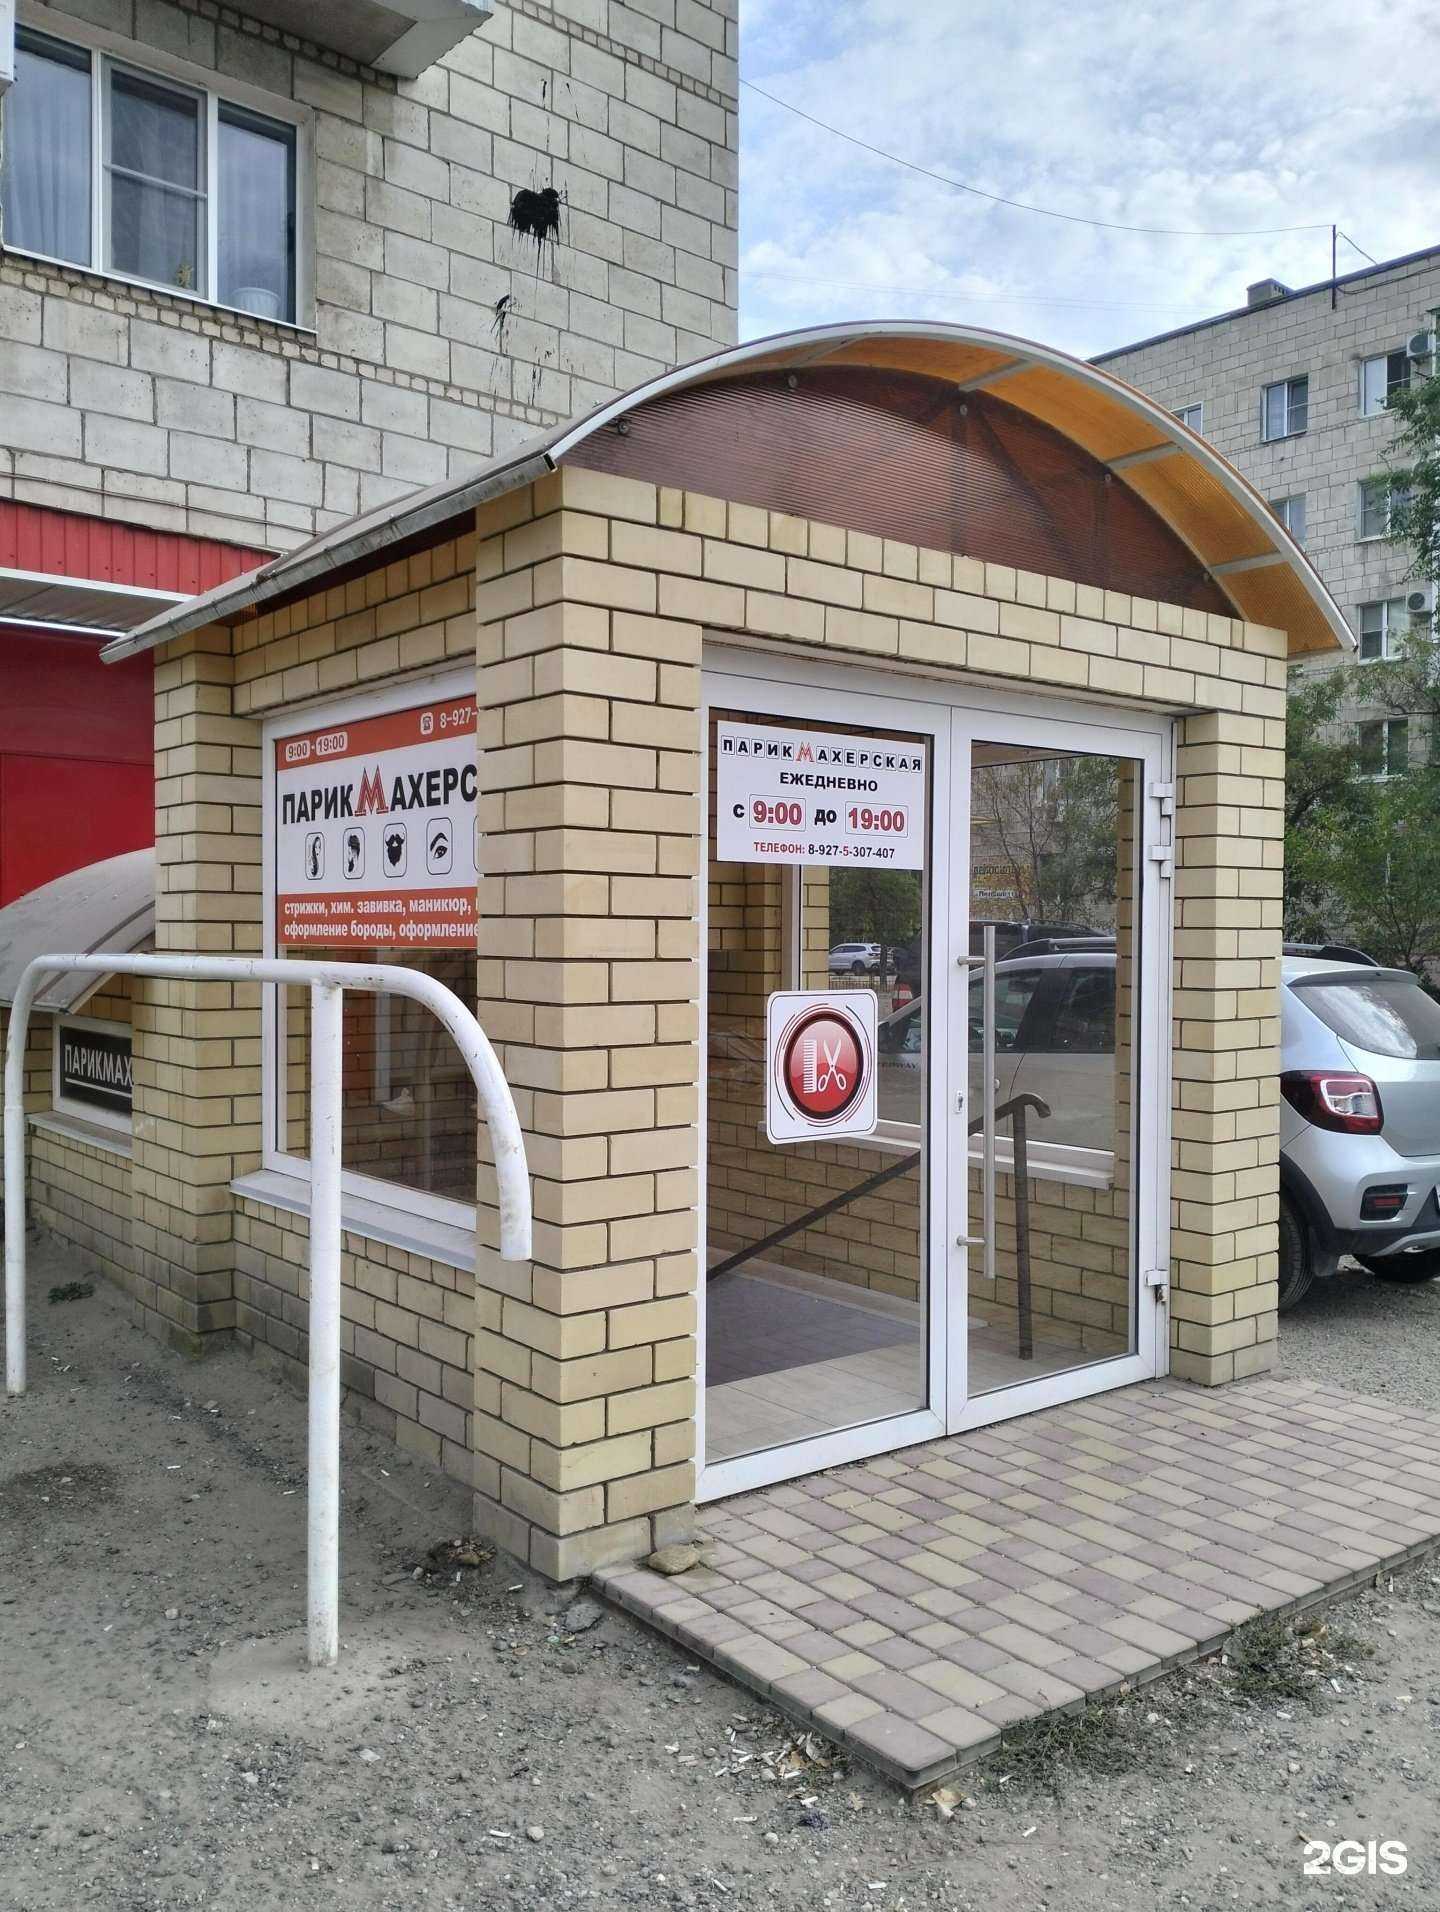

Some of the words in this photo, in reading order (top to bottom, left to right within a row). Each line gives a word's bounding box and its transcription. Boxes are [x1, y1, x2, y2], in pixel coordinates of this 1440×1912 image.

[288, 742, 308, 759] 9:00
[318, 734, 345, 753] 19:00
[722, 739, 921, 771] ПАРИКМАХЕРСКАЯ
[282, 763, 478, 825] ПАРИКМАХЕРС
[780, 772, 878, 792] ЕЖЕДНЕВНО
[753, 800, 802, 826] 9:00
[848, 807, 905, 832] 19:00
[754, 841, 805, 855] ТЕЛЕФОН:
[808, 843, 895, 859] 8-927-5-307-407
[284, 900, 328, 918] стрижки,
[330, 901, 354, 914] хим.
[357, 899, 406, 916] завивка,
[409, 897, 472, 917] маникюр,
[284, 920, 348, 940] оформление
[350, 920, 396, 941] бороды,
[65, 1043, 133, 1087] ПАРИКМАХ
